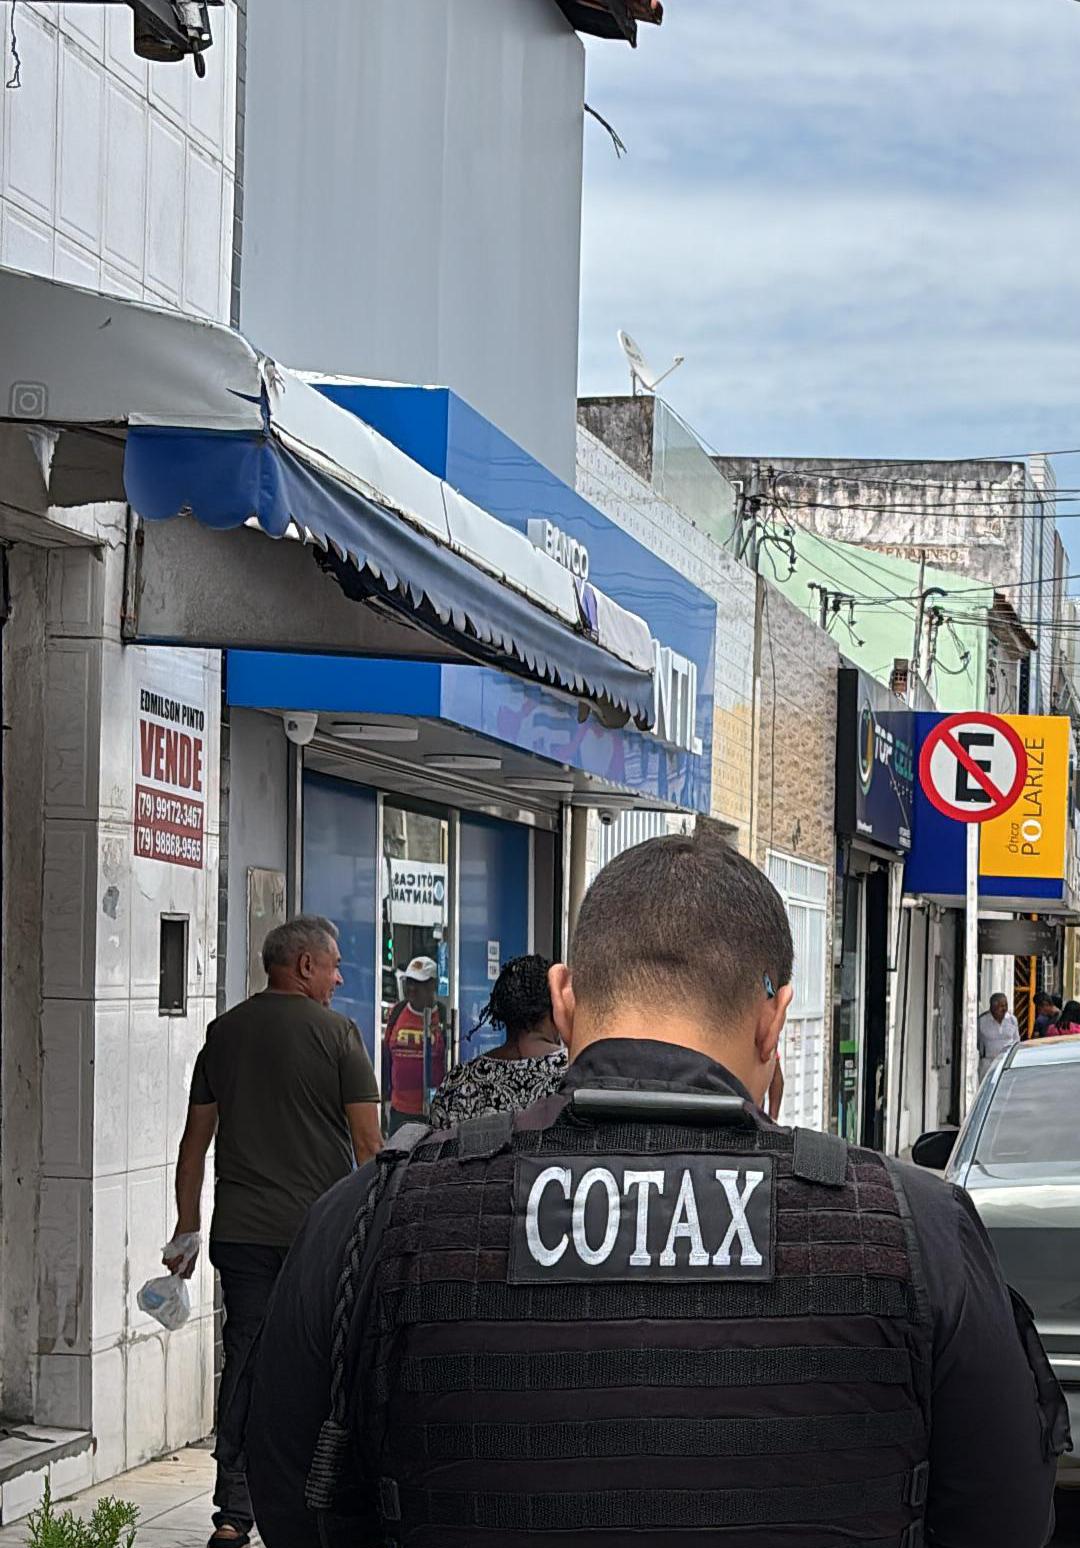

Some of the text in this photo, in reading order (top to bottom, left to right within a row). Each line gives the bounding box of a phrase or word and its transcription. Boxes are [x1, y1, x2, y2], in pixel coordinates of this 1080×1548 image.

[542, 518, 589, 580] BANCO
[140, 688, 205, 732] EDMILSON PINTO
[651, 638, 703, 756] NTIL
[139, 719, 203, 793] VENDE
[874, 723, 894, 766] TOP
[955, 731, 995, 803] E
[137, 791, 202, 830] (79) 99172-3467
[1021, 737, 1045, 856] POLARIZE
[136, 826, 154, 856] (79)
[525, 1166, 764, 1266] COTAX
